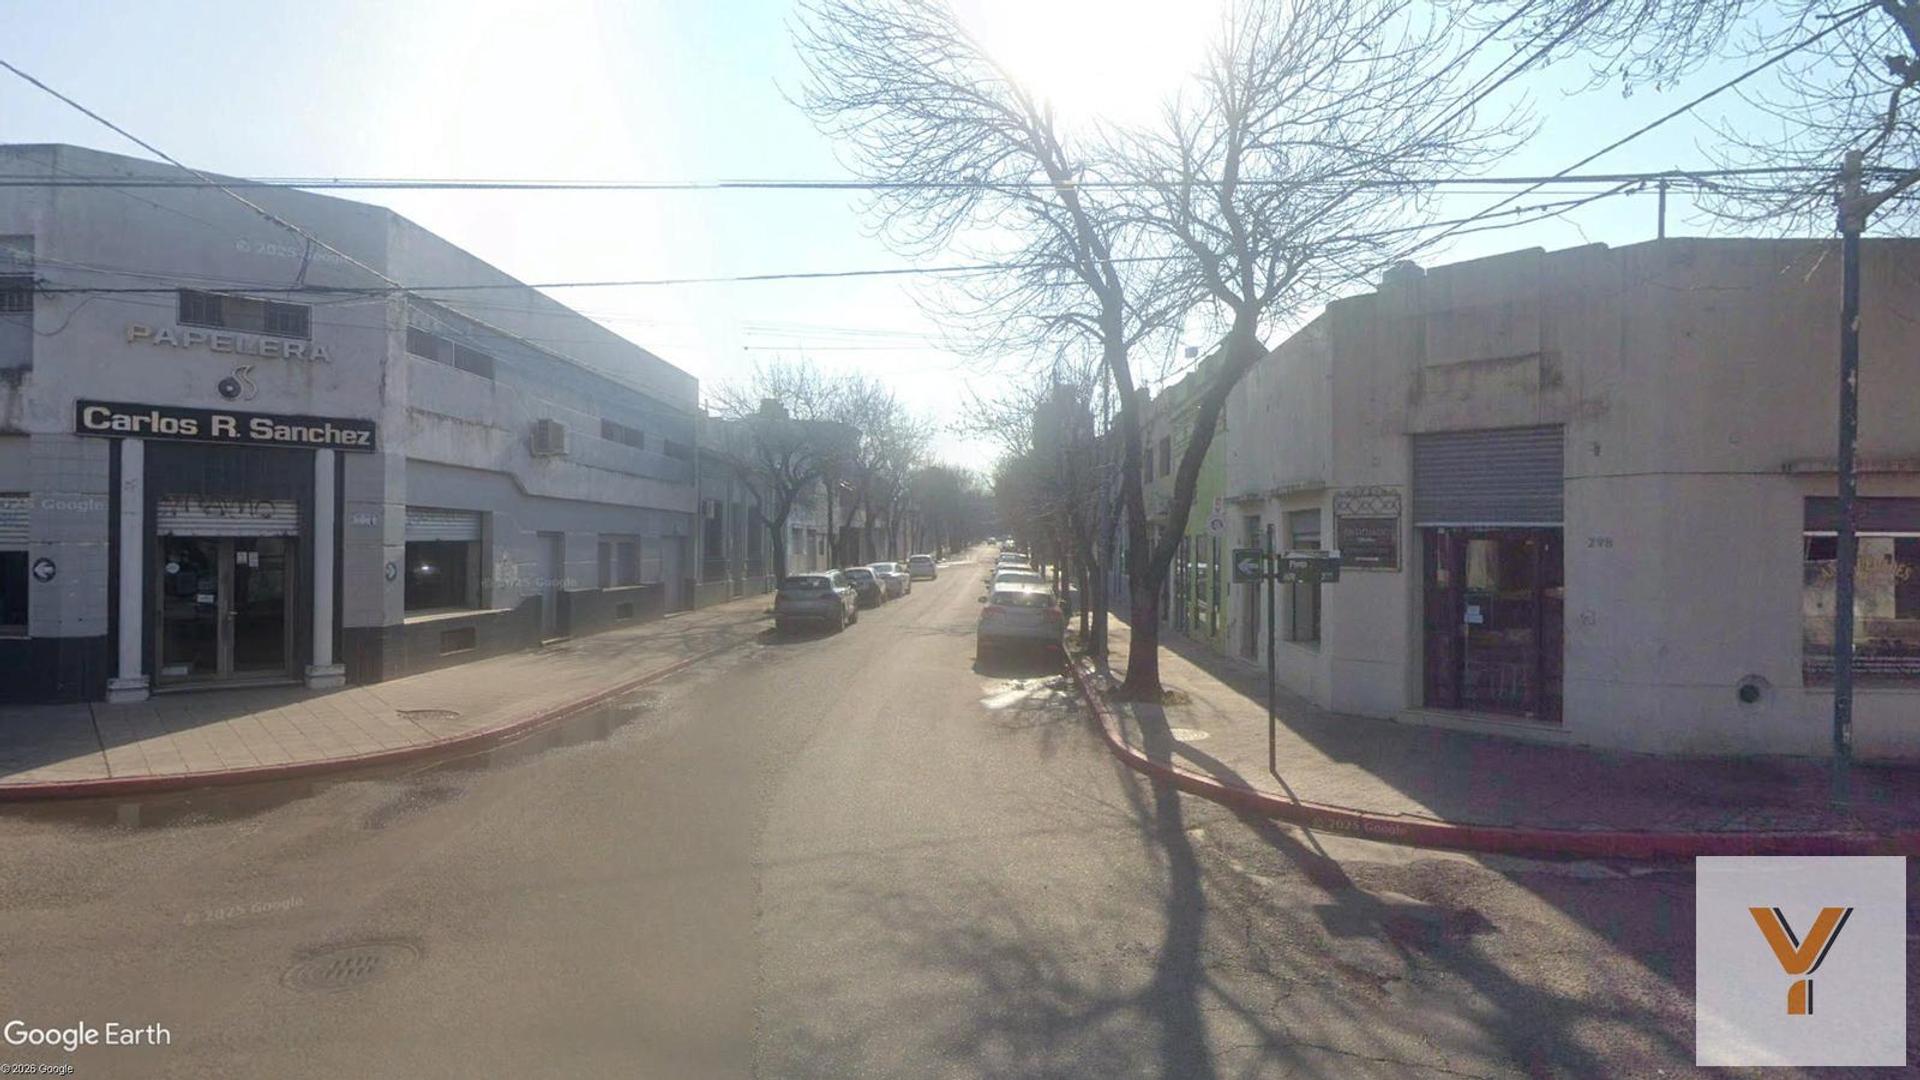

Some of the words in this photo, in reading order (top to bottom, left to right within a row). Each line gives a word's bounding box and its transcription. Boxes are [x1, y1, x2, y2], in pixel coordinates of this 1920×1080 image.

[127, 322, 333, 362] PAPELERA
[83, 406, 199, 435] Carlos
[211, 415, 241, 438] R.
[250, 417, 370, 446] Sanchez
